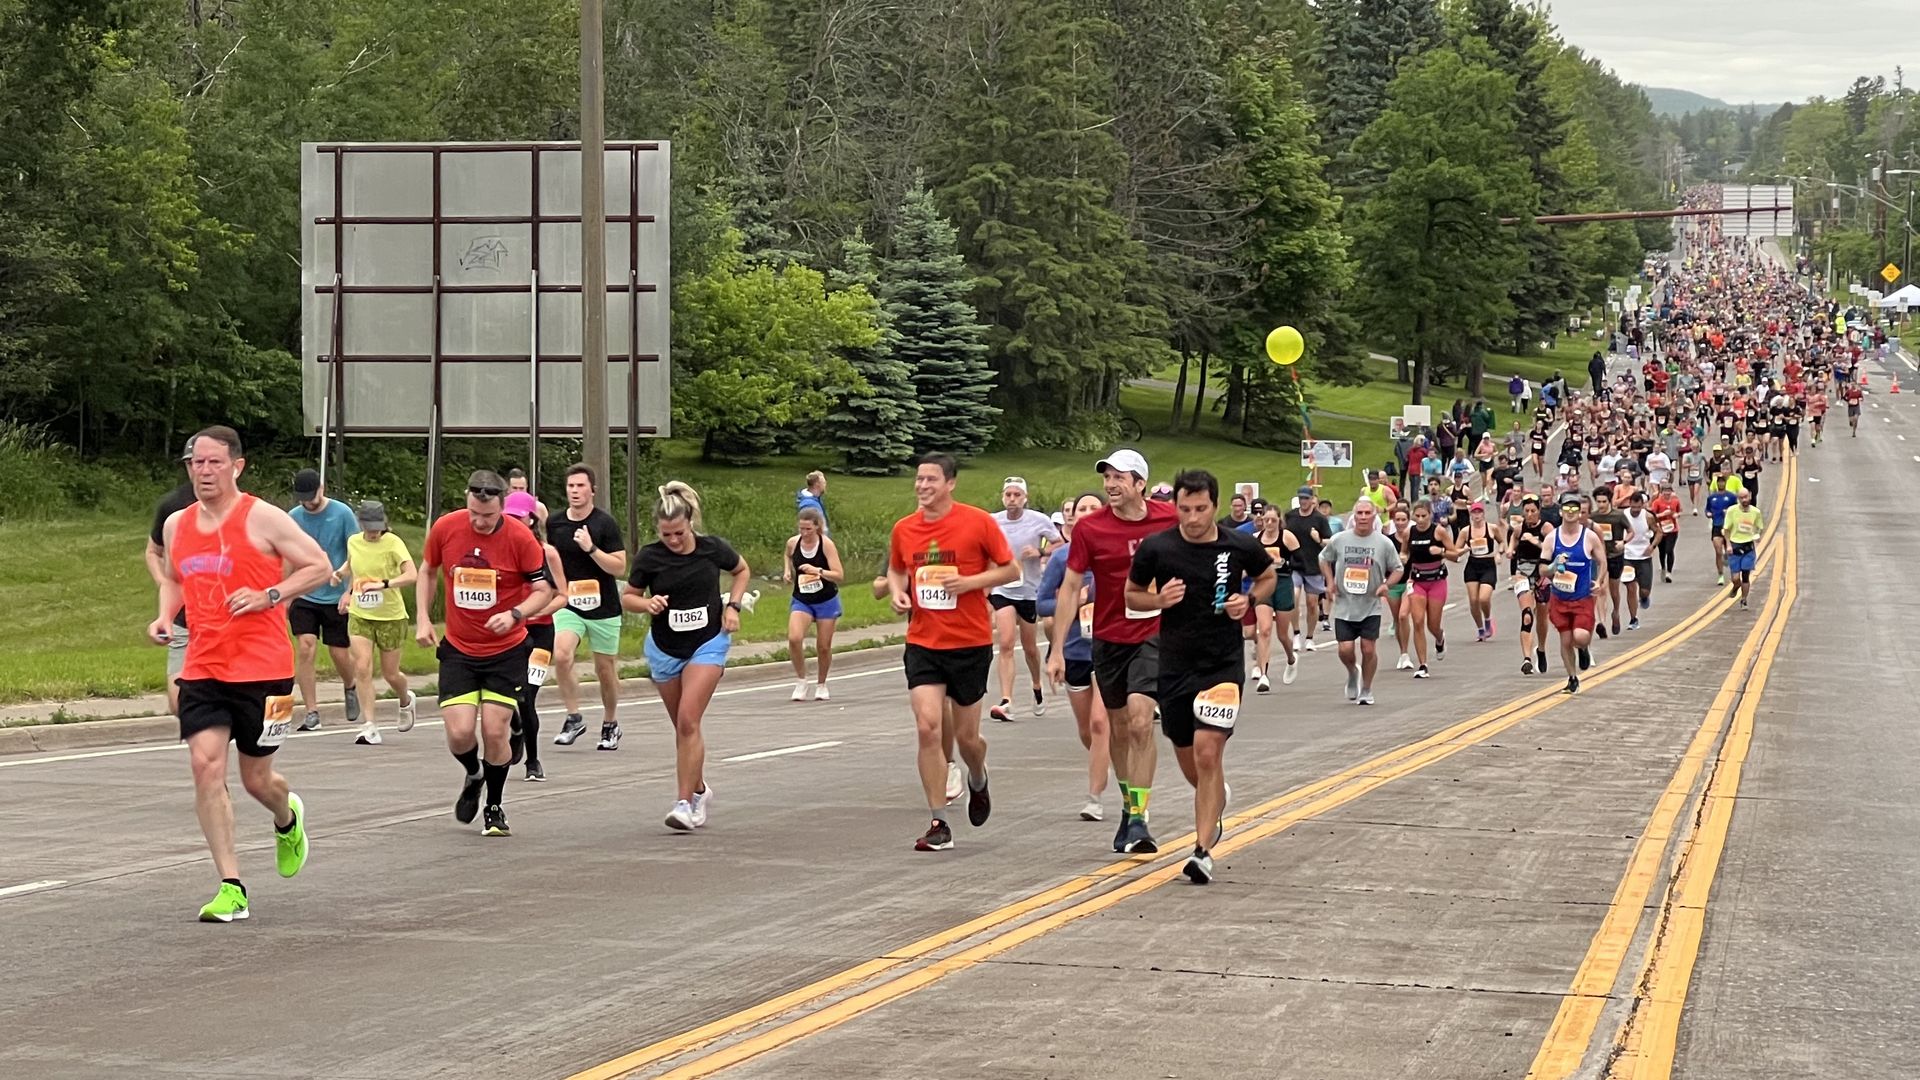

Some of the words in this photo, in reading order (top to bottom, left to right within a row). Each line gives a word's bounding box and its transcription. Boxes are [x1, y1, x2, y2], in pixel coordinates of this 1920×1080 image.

[357, 594, 379, 603] 12711
[459, 590, 492, 602] 11403
[573, 596, 598, 606] 12473
[673, 610, 703, 623] 11362
[527, 667, 546, 680] 717
[1199, 704, 1234, 720] 13248
